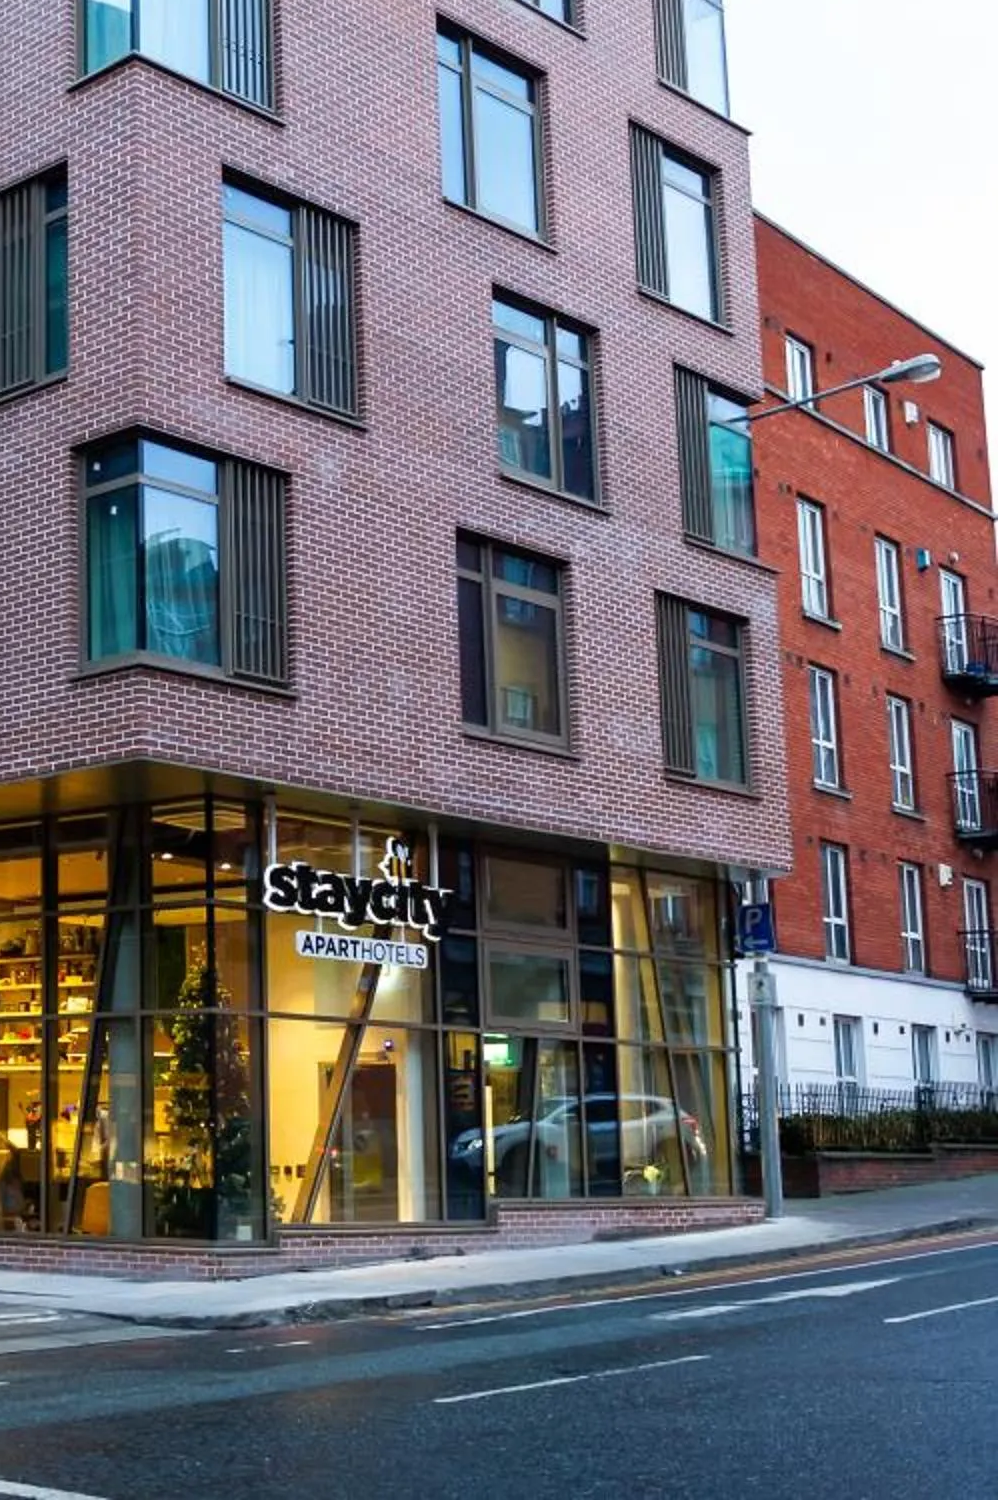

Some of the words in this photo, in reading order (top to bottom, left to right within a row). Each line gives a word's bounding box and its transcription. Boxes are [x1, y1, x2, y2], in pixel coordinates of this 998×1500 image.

[262, 861, 455, 940] staycity
[745, 908, 763, 934] P
[301, 935, 426, 967] APARTHOTELS
